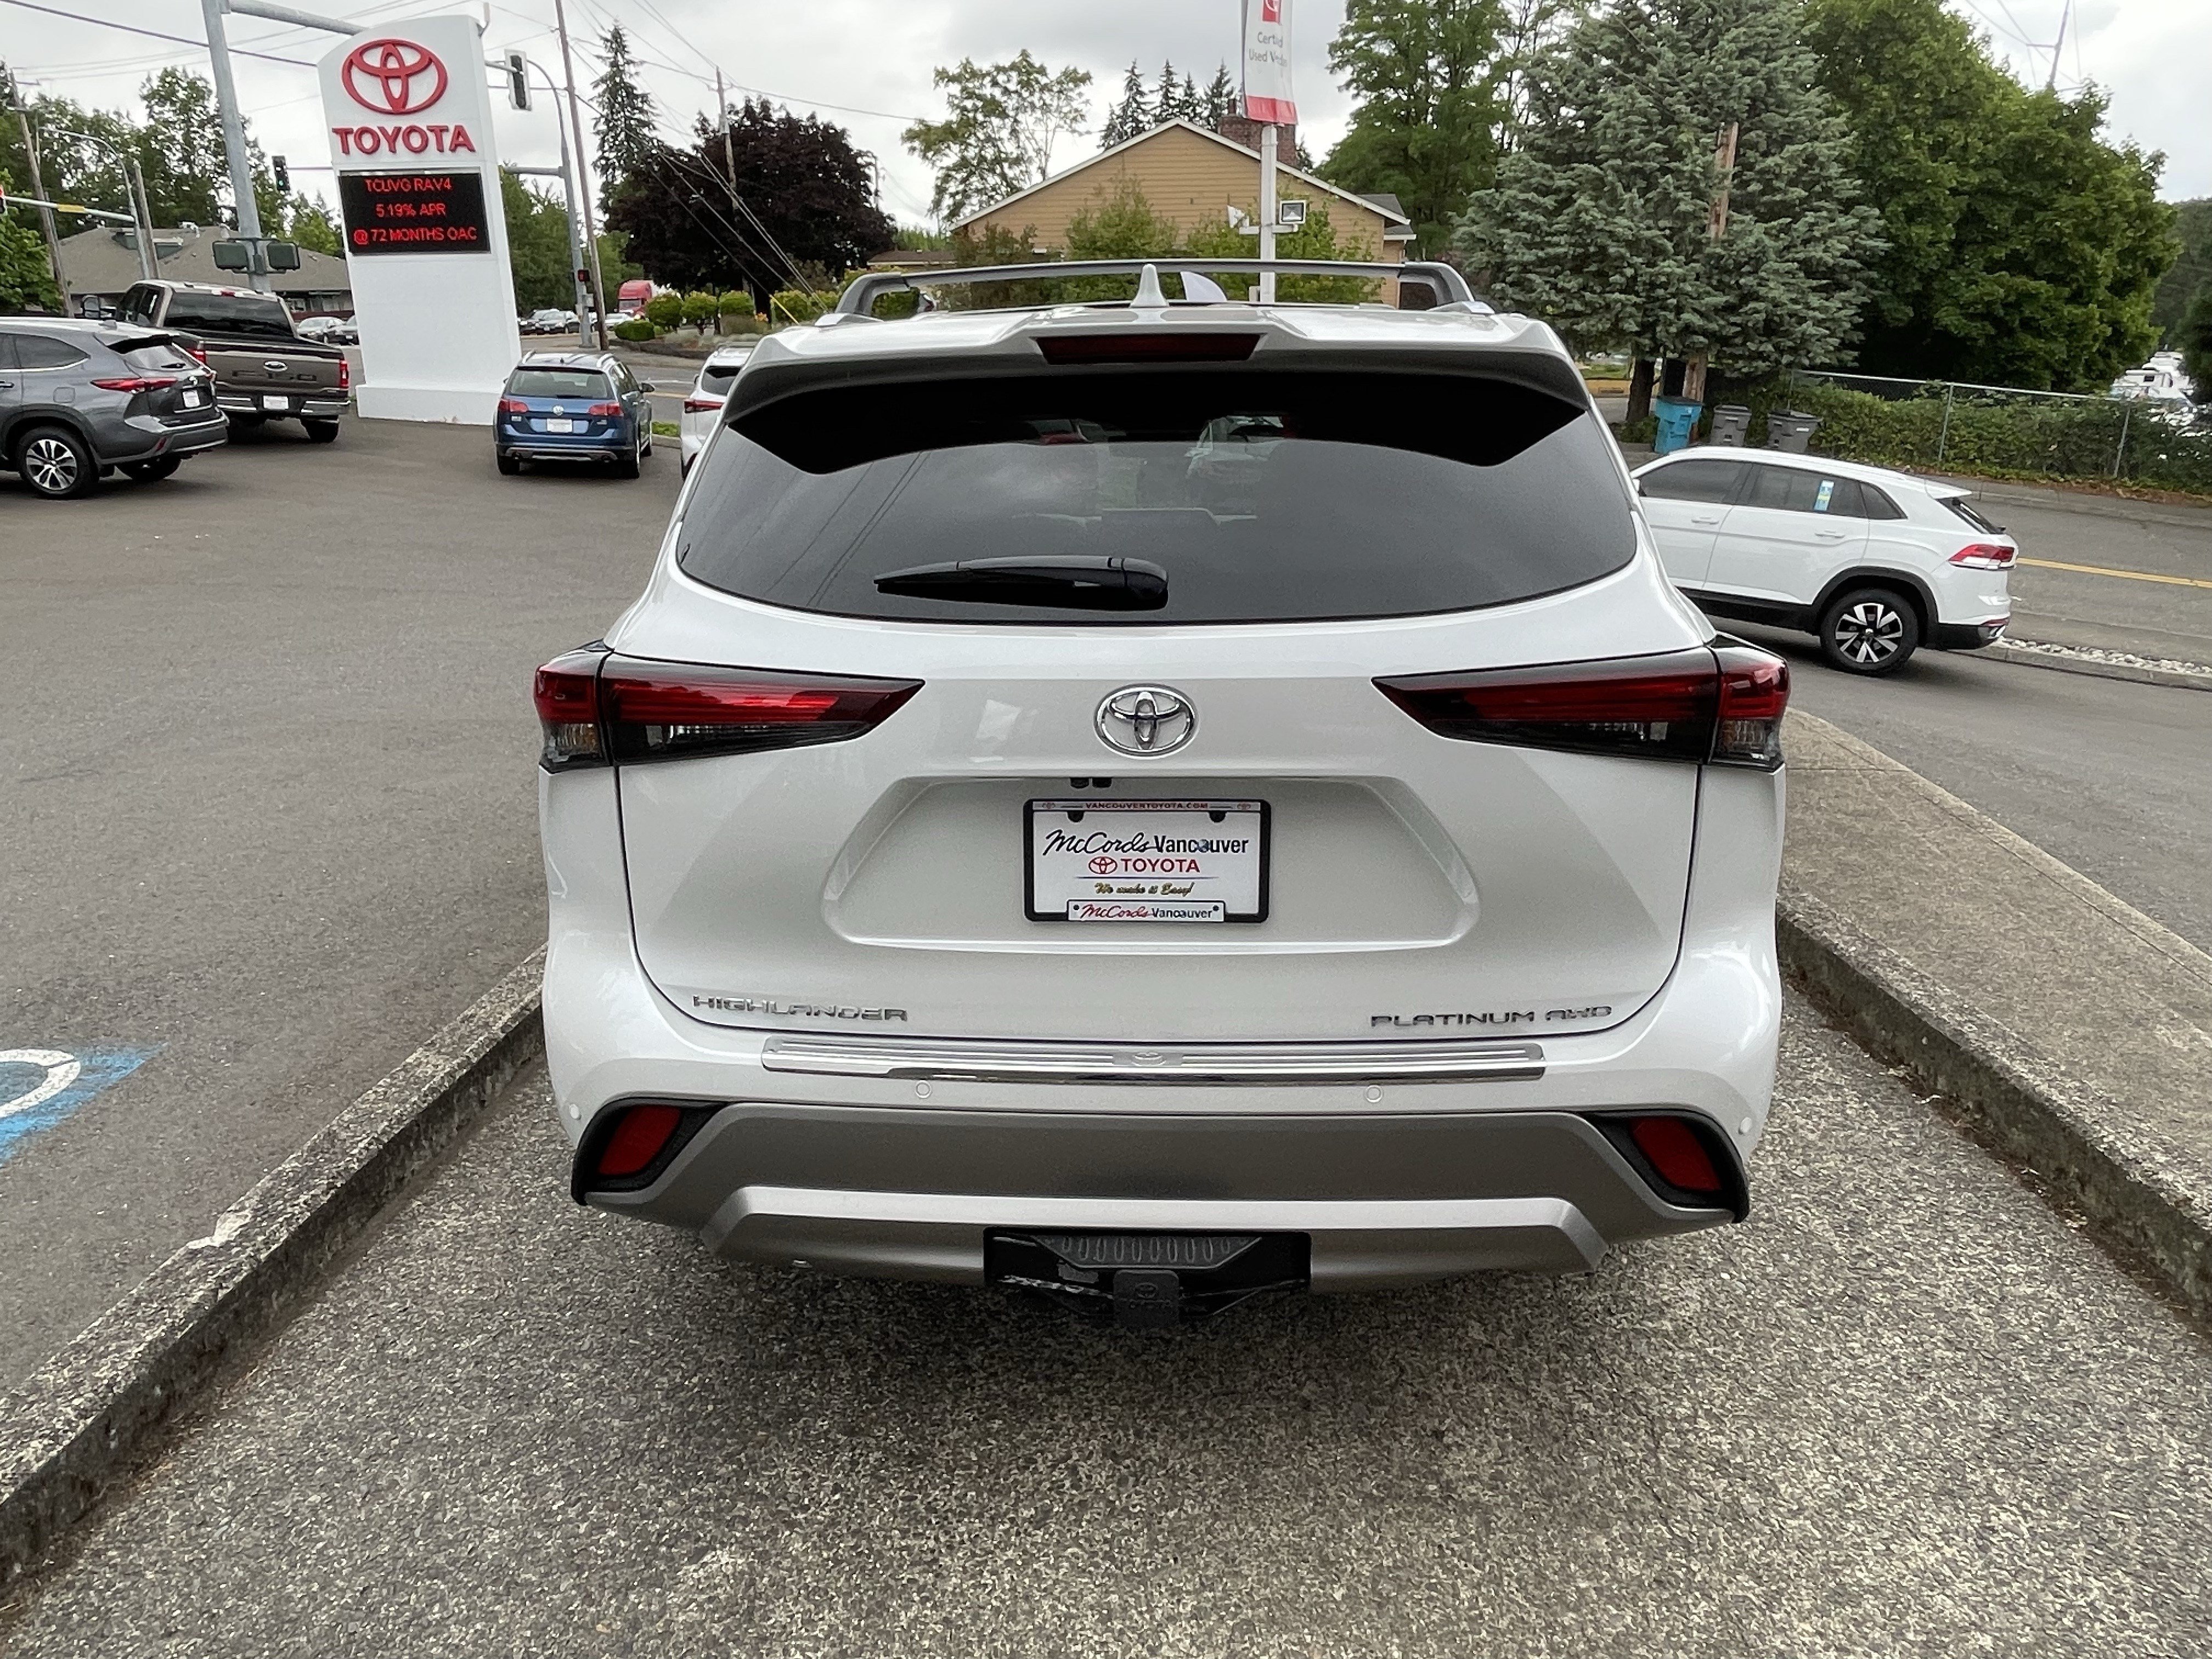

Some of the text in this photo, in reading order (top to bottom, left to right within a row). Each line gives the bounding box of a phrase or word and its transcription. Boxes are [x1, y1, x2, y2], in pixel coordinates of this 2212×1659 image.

[1249, 48, 1267, 62] Used
[332, 125, 476, 154] TOYOTA
[414, 177, 452, 191] RAV4
[419, 203, 447, 216] APR
[370, 229, 387, 241] 72
[389, 227, 444, 241] MONTHS
[447, 227, 477, 240] OAC
[1043, 829, 1249, 856] McCords Vancouver
[1121, 858, 1200, 873] TOYOTA
[1080, 904, 1212, 918] McCords Vancouver
[692, 995, 908, 1022] HIGHLANDER
[1371, 1005, 1612, 1028] PLATINUM AWD
